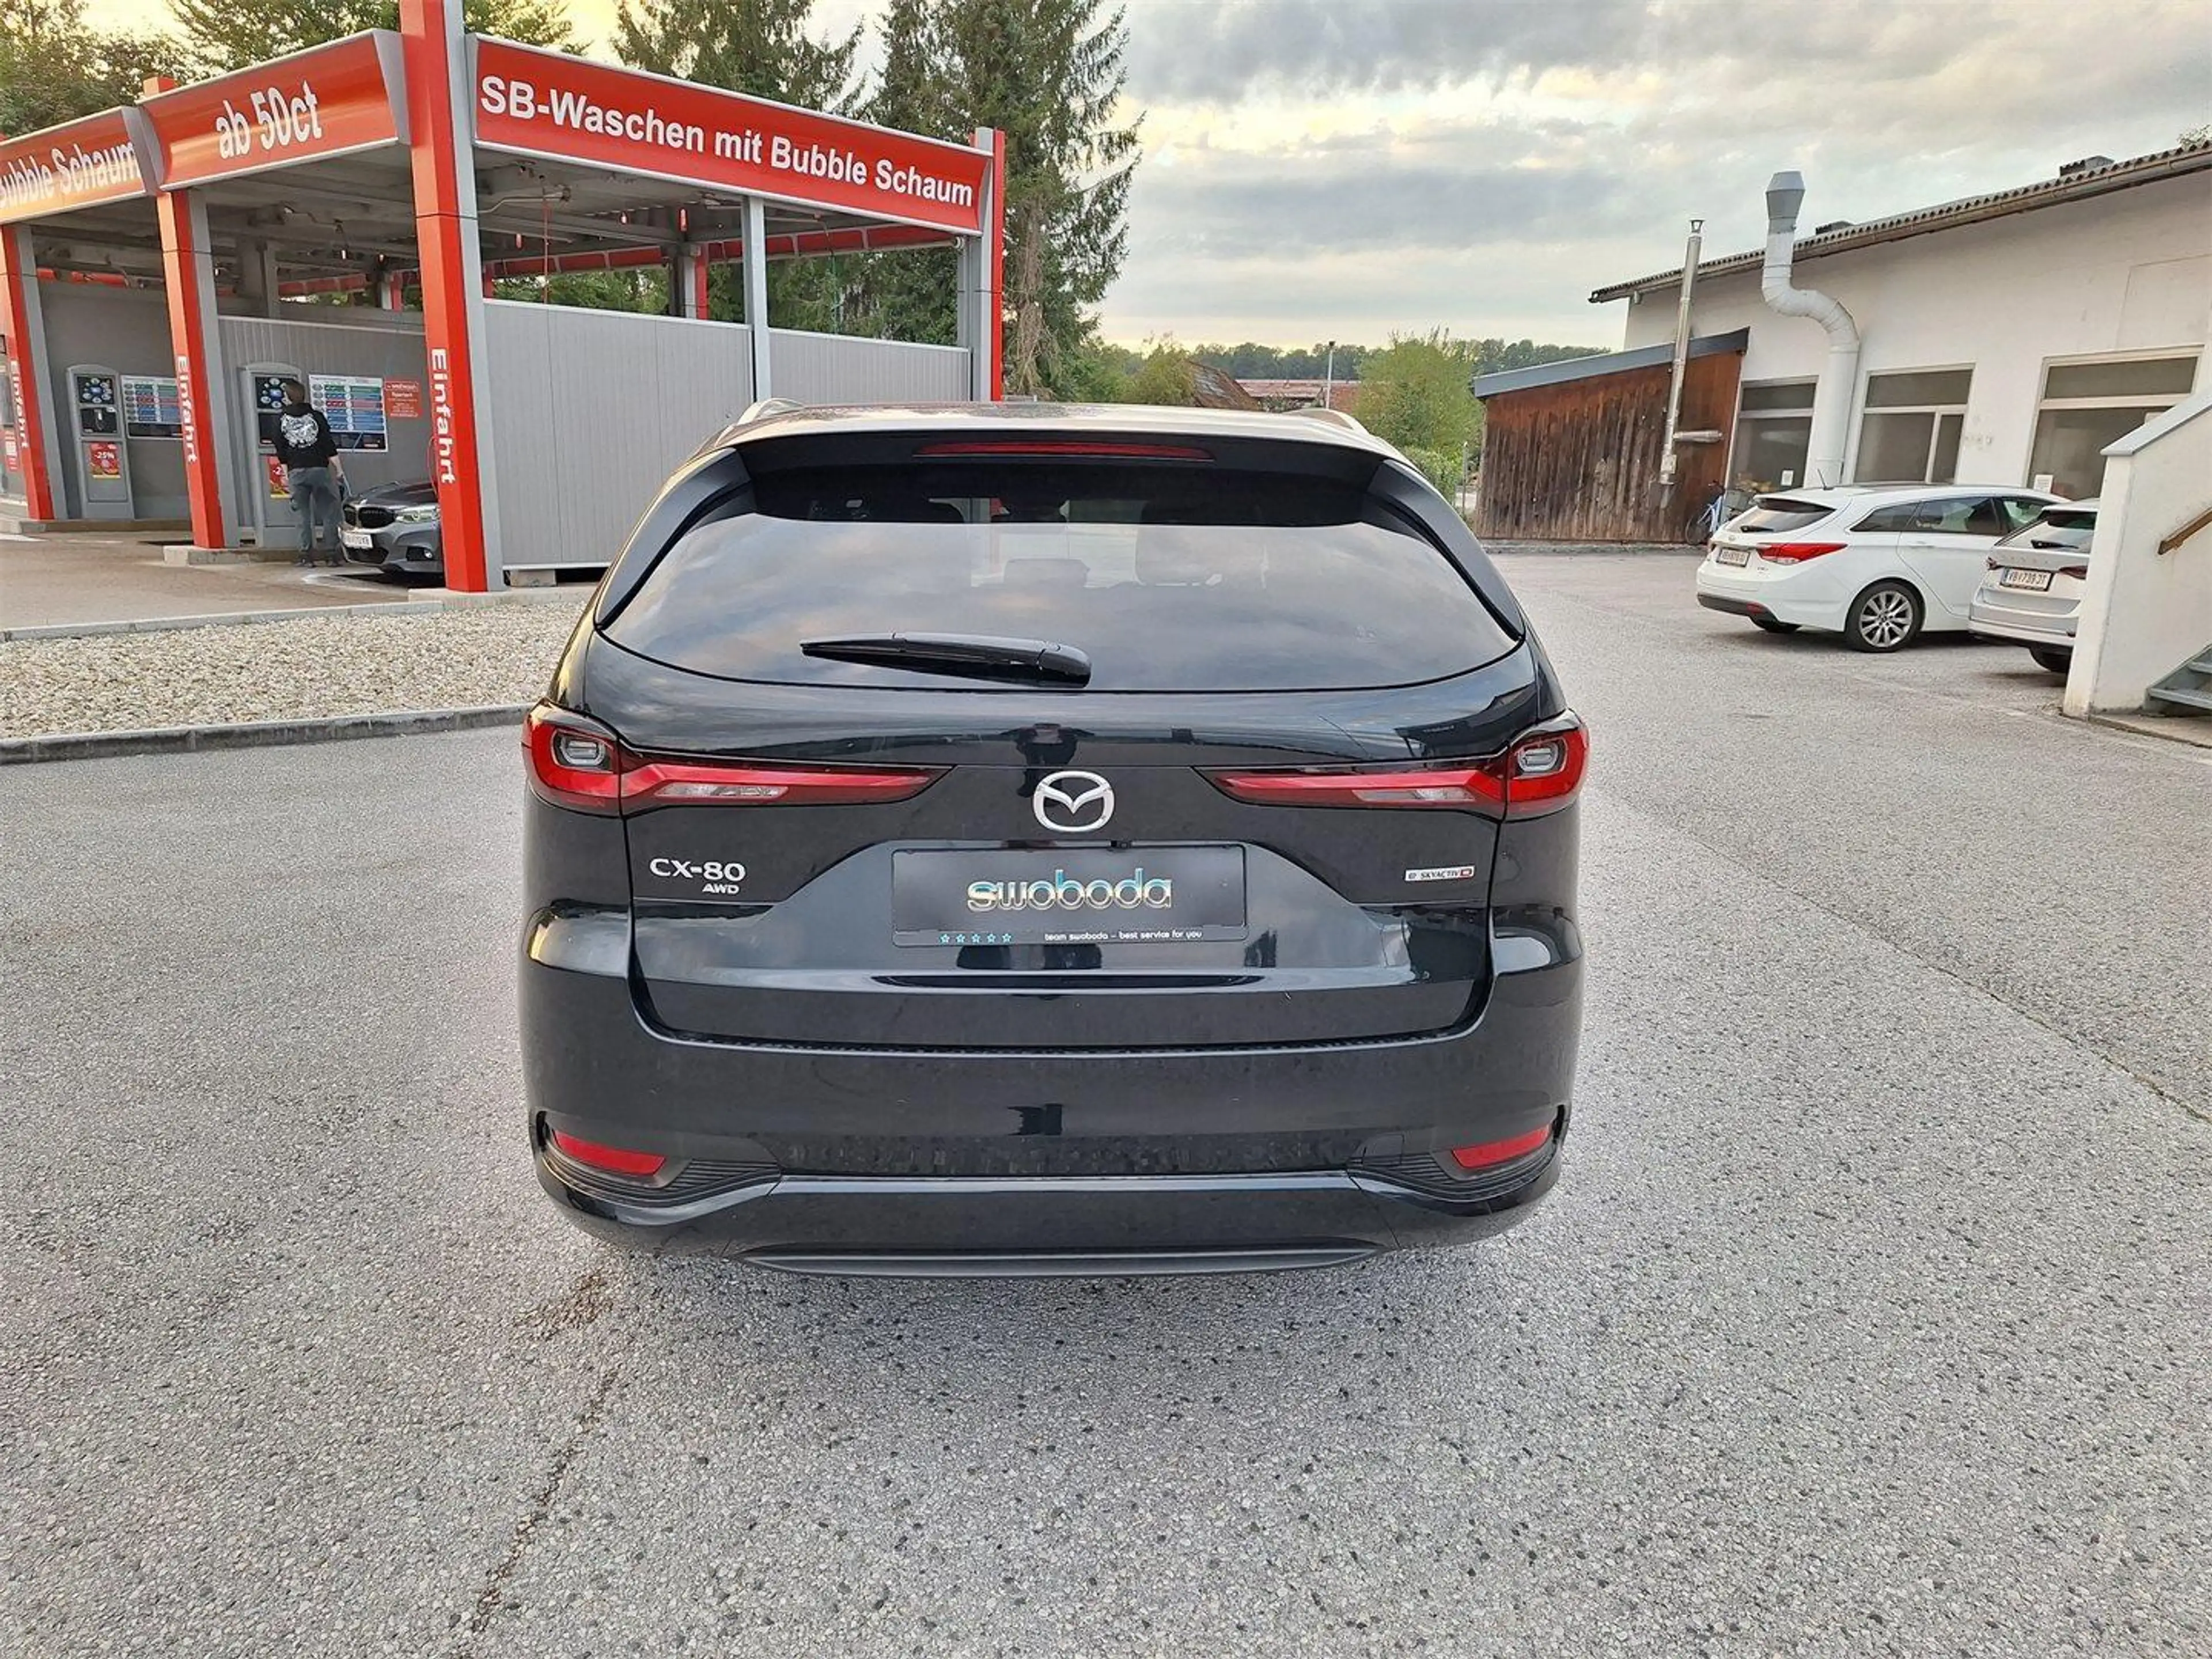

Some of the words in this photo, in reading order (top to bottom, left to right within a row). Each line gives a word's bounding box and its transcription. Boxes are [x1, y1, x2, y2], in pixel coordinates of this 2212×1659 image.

[216, 99, 251, 159] ab
[250, 79, 322, 150] 50ct
[480, 75, 704, 153] SB-Waschen
[714, 130, 763, 164] mit
[770, 135, 868, 185] Bubble
[874, 159, 974, 207] Schaum
[177, 355, 198, 463] Einfahrt
[432, 348, 457, 484] Einfahrt
[649, 858, 746, 882] CX-80
[702, 883, 740, 895] AWD
[967, 867, 1172, 912] swoboda
[1044, 933, 1067, 941] team
[1069, 932, 1109, 941] swoboda
[1119, 930, 1139, 940] best
[1140, 930, 1170, 940] service
[1172, 929, 1184, 938] for
[1185, 931, 1203, 940] you
